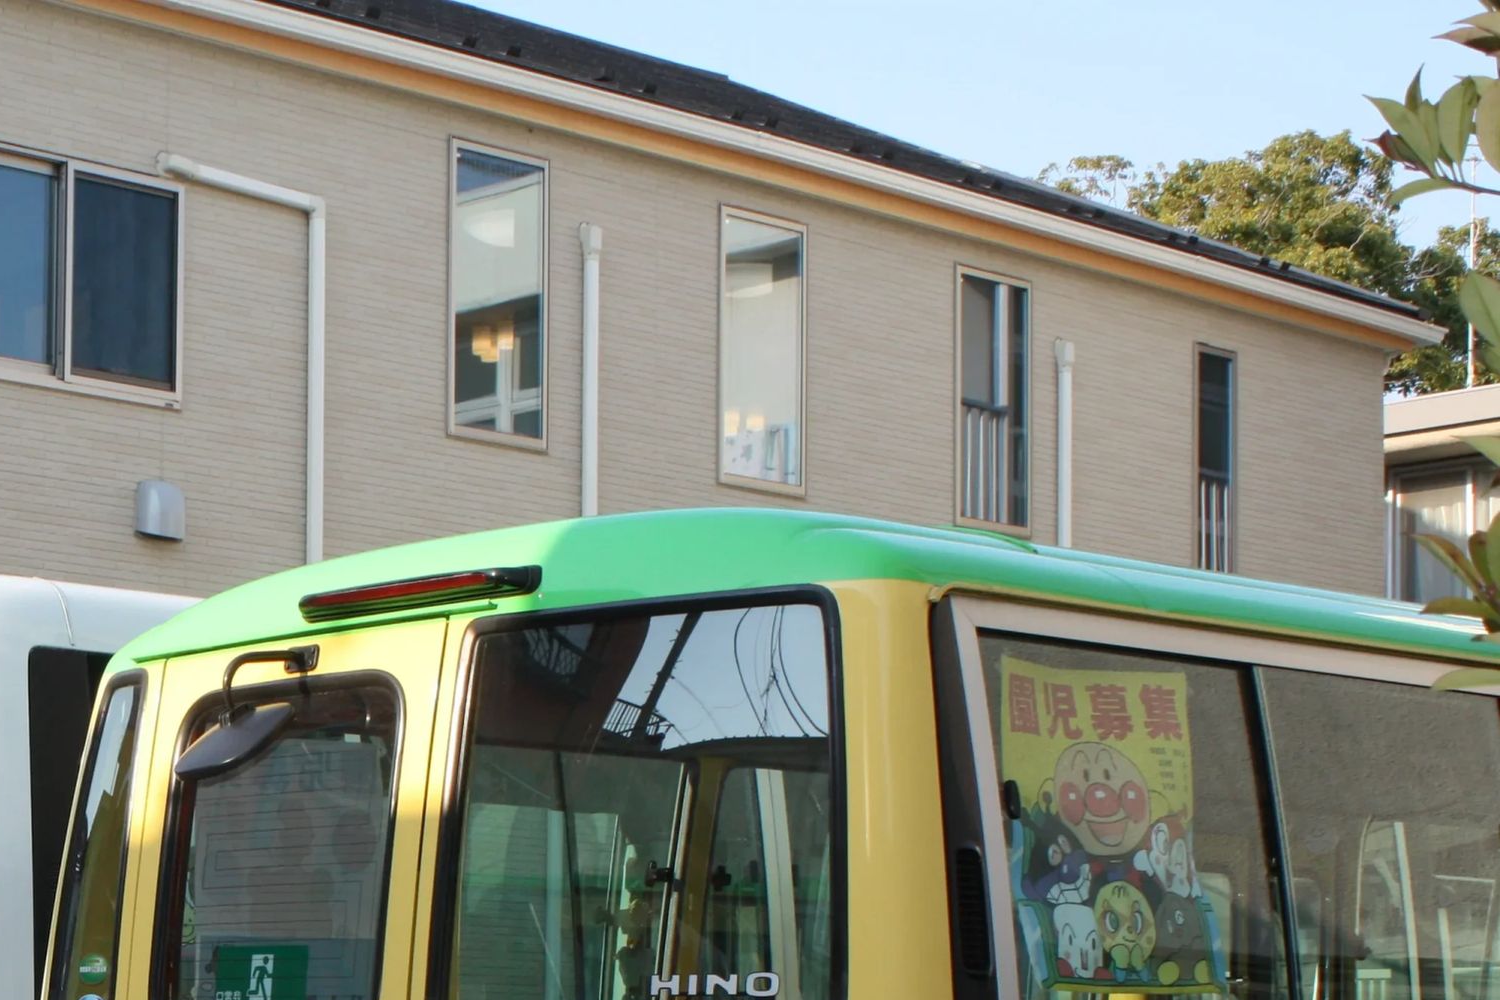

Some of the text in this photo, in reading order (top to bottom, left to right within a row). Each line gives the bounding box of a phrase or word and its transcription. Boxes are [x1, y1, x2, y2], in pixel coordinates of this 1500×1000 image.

[1008, 672, 1183, 741] 園児募集
[650, 972, 780, 997] HINO
